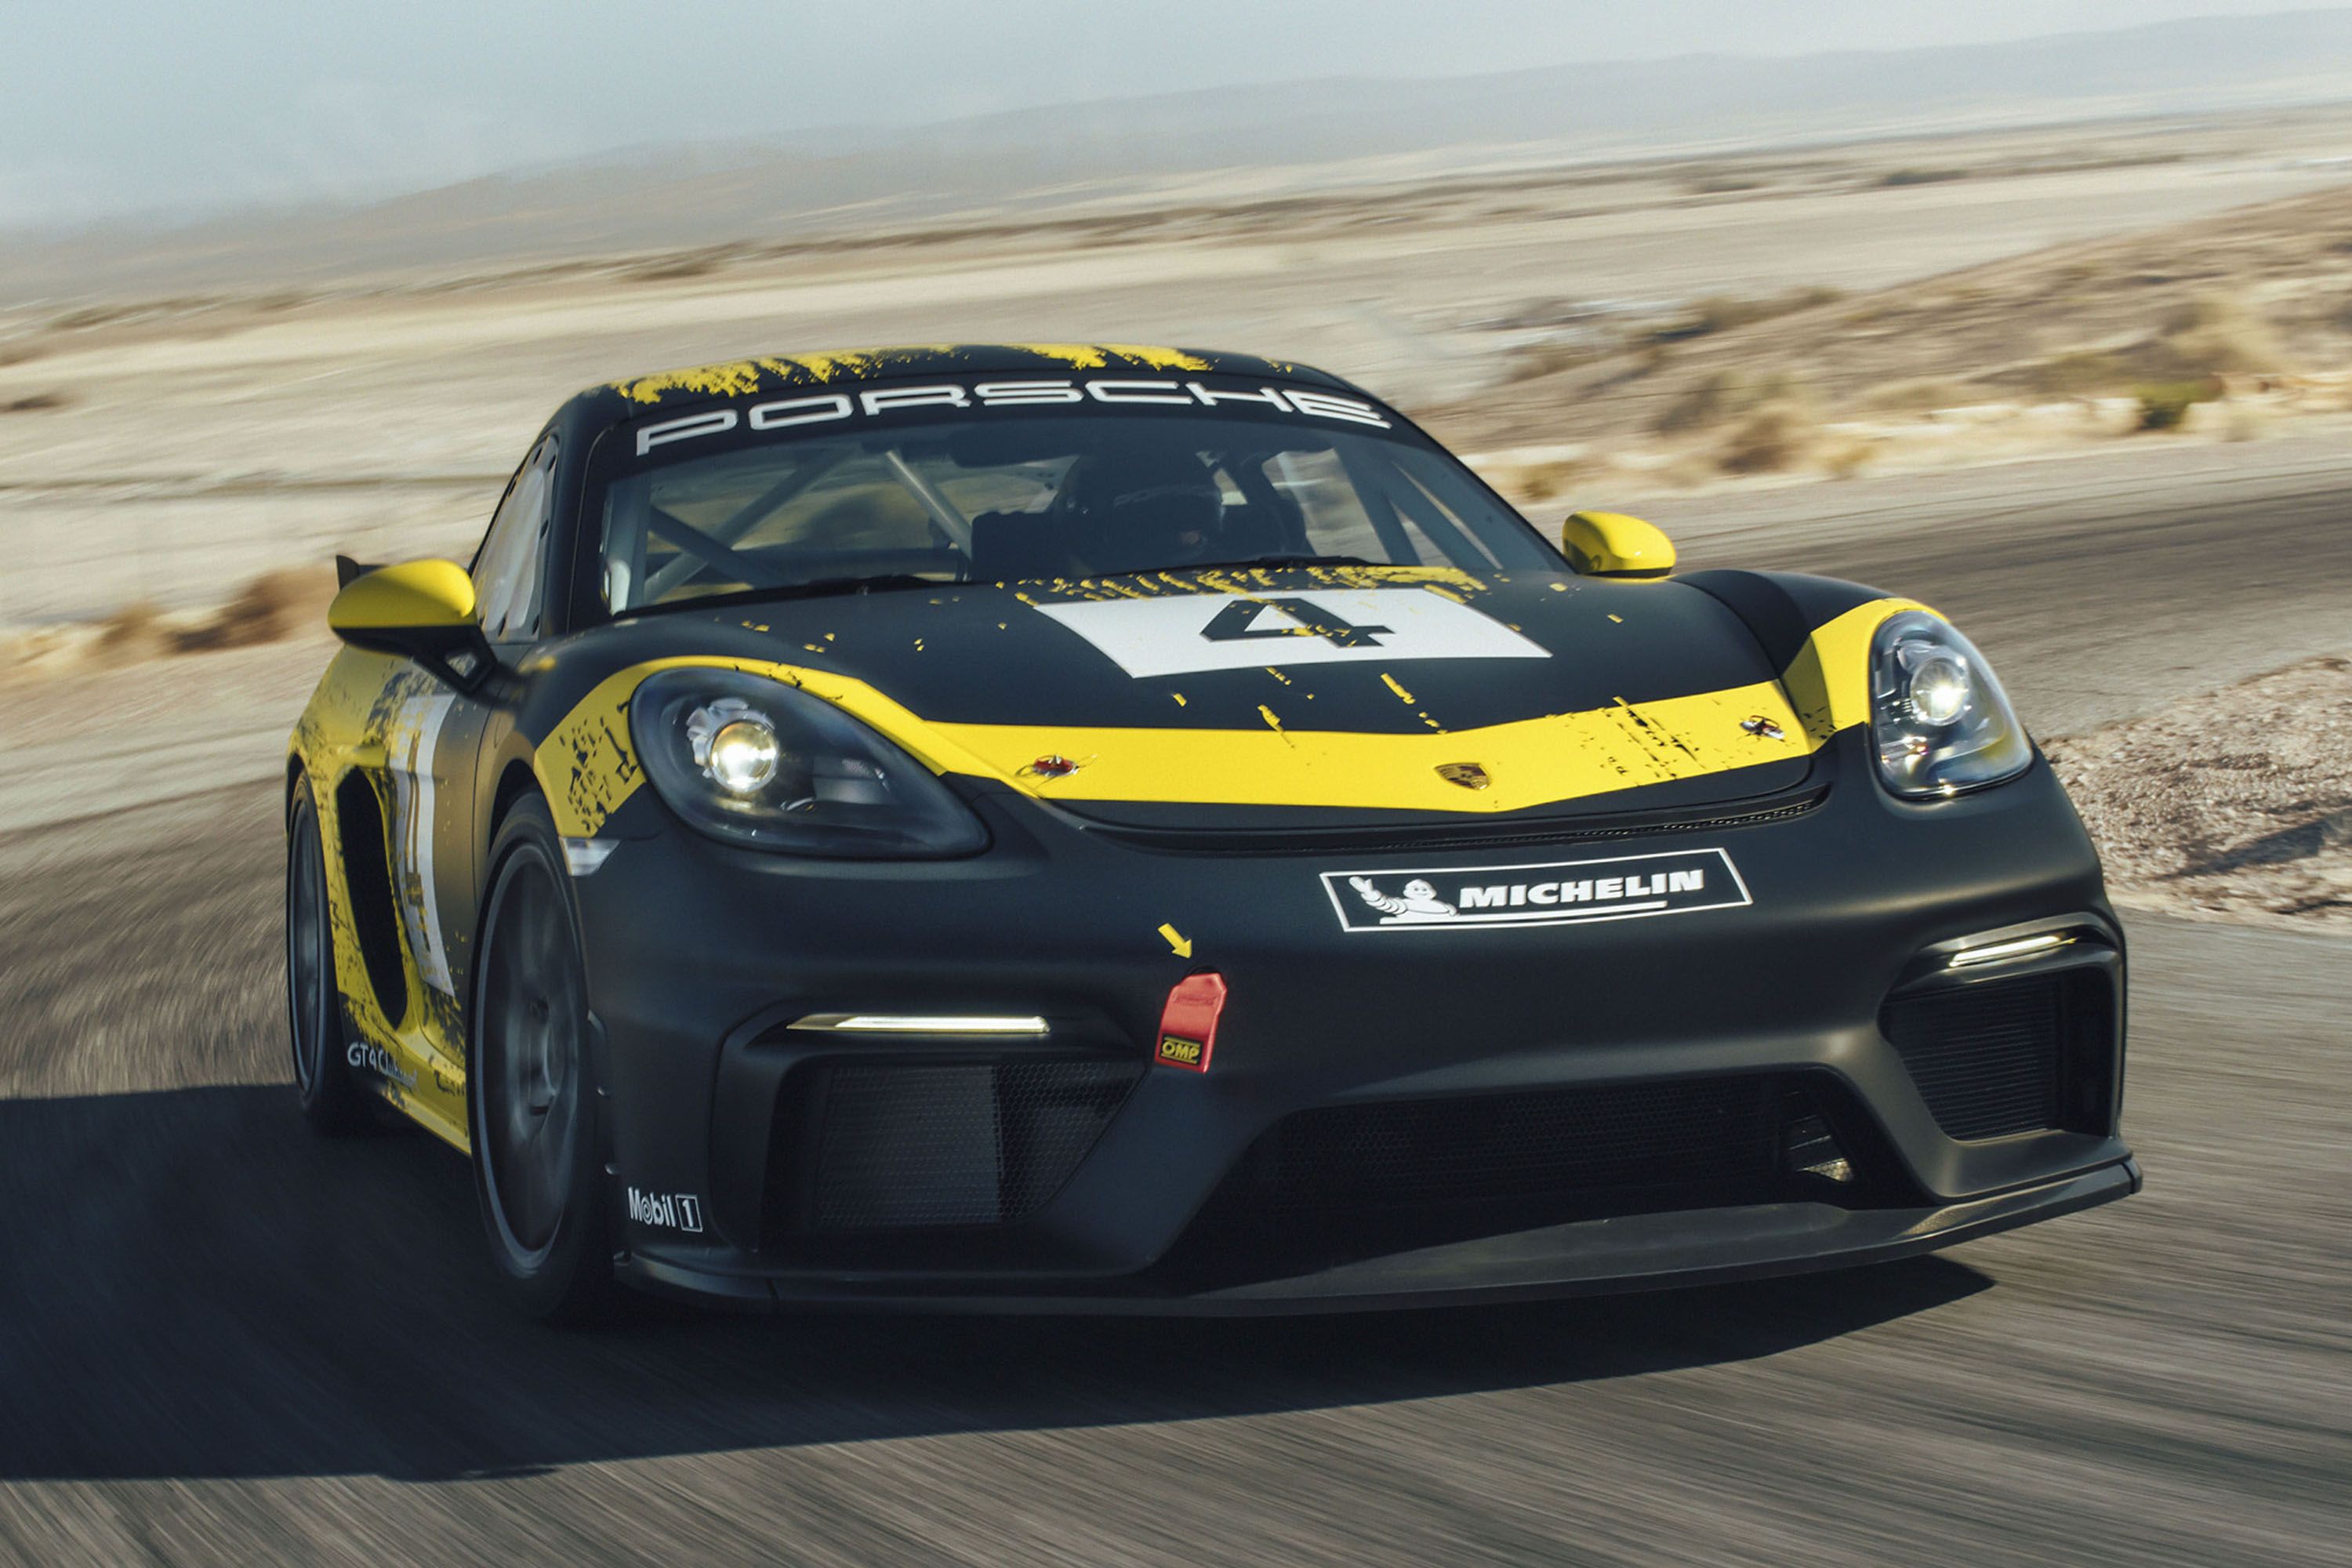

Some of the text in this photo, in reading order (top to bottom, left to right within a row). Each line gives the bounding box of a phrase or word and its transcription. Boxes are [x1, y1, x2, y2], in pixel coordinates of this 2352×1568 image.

[636, 380, 1392, 456] PORSCHE
[1199, 597, 1396, 648] 4
[1459, 869, 1704, 910] MICHELIN
[1162, 1041, 1200, 1060] OMP
[628, 1186, 676, 1227] Mobil
